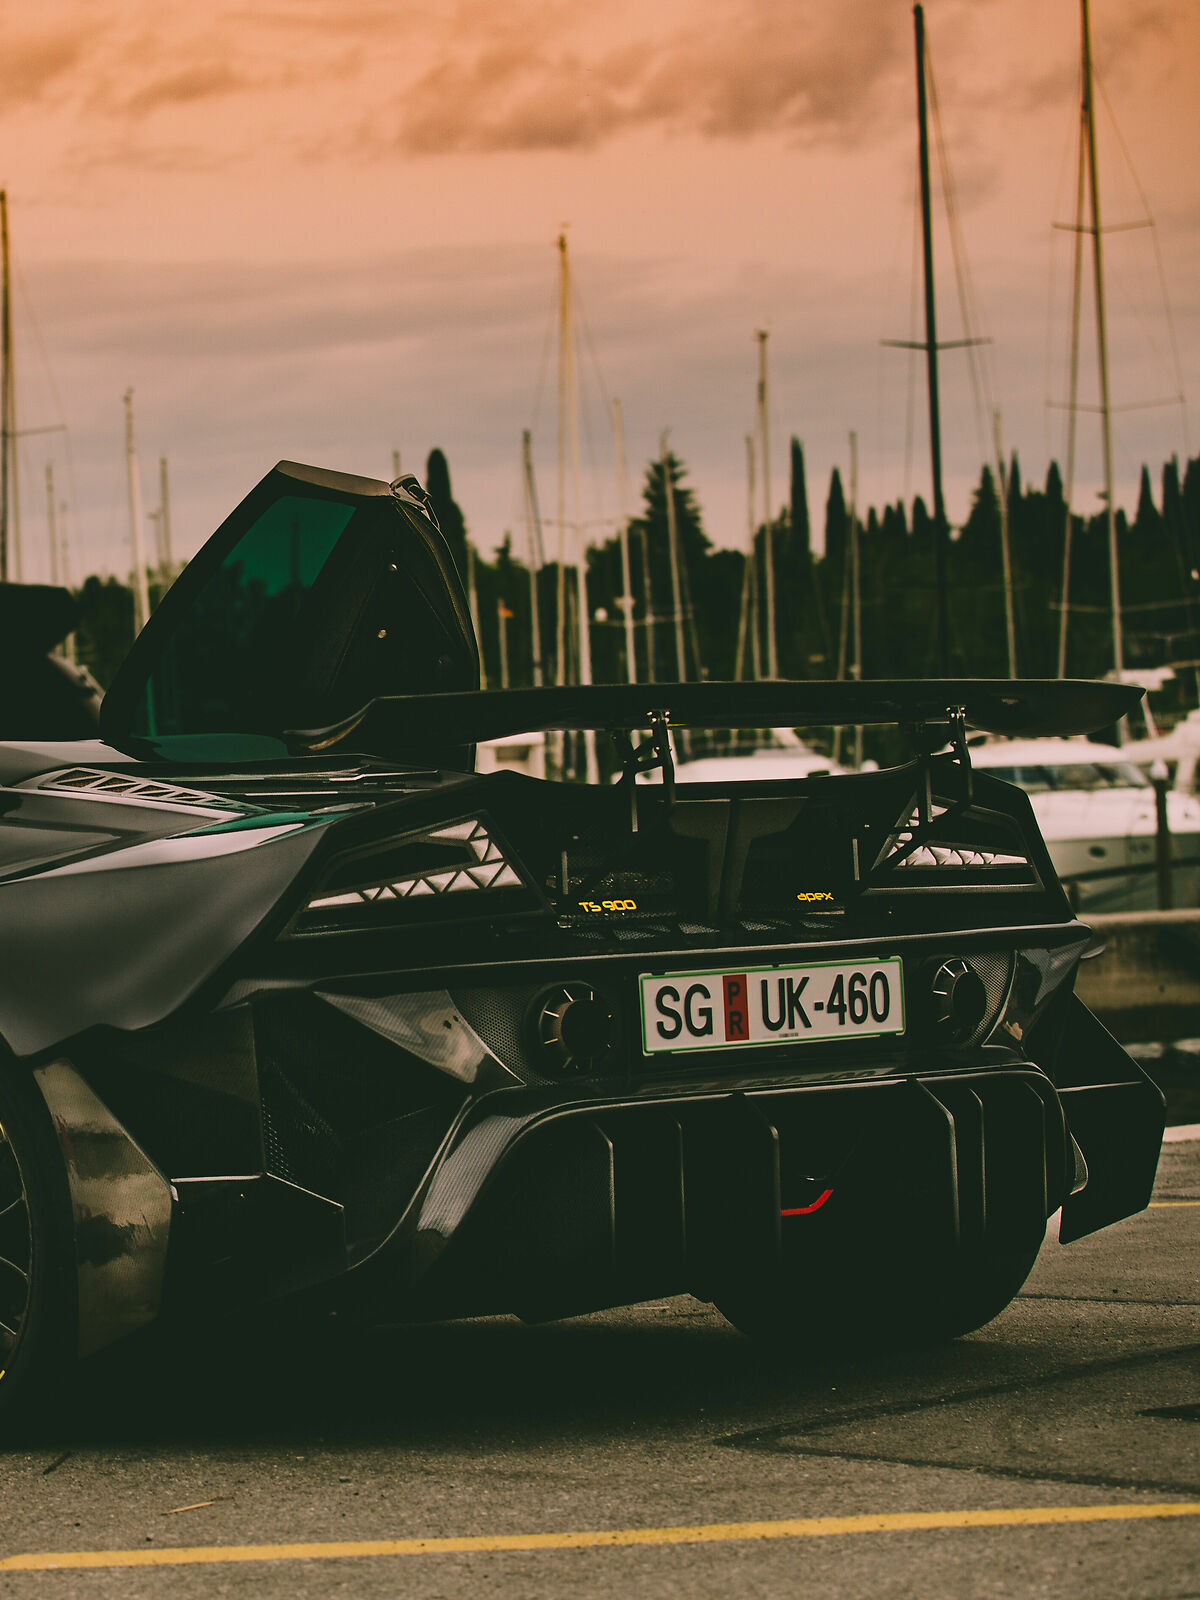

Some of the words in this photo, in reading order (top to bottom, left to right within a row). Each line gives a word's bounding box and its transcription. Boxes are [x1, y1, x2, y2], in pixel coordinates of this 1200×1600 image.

[797, 892, 835, 902] apex
[578, 901, 602, 912] TS
[602, 899, 637, 911] 900
[656, 984, 714, 1040] SG
[761, 971, 890, 1031] UK-460
